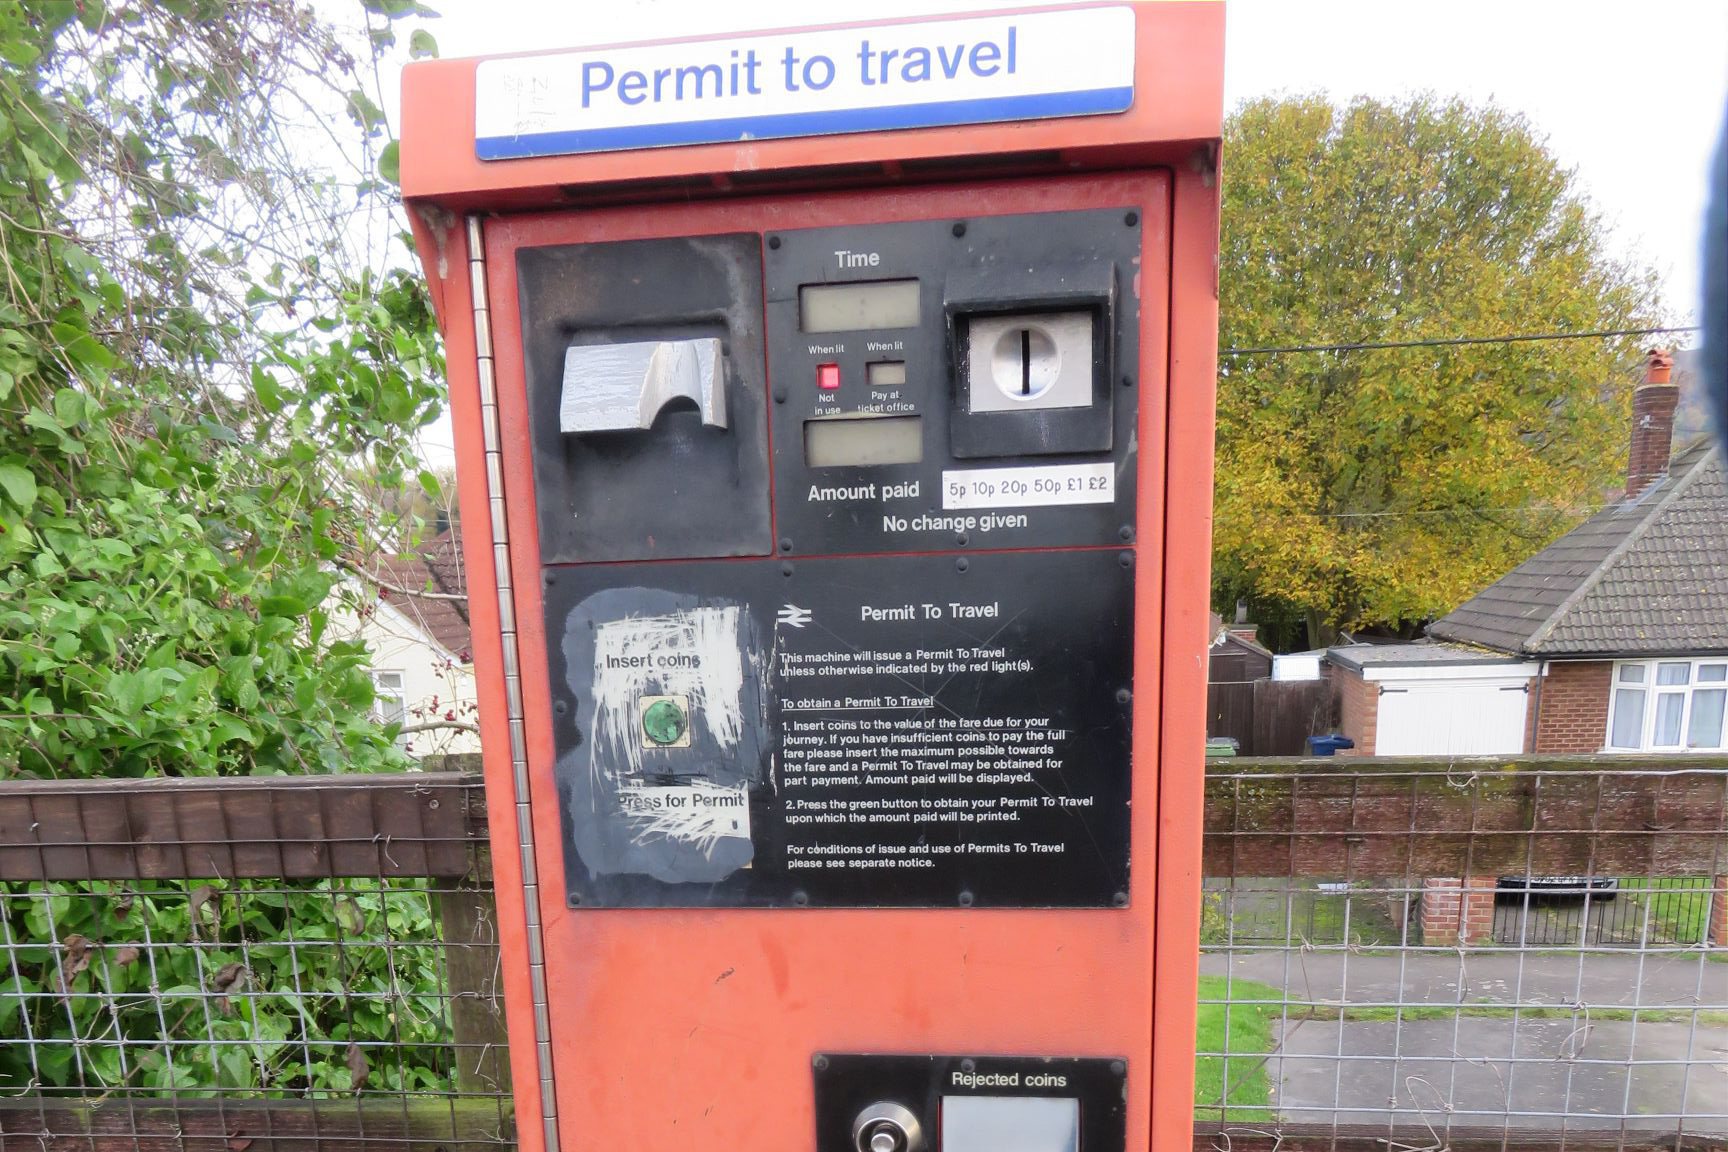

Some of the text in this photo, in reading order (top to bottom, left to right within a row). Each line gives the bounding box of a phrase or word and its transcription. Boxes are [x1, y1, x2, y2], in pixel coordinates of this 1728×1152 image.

[581, 49, 762, 108] Permit
[781, 46, 836, 91] to
[857, 26, 1017, 85] travel
[834, 250, 880, 269] Time
[808, 343, 845, 355] When lit
[867, 341, 903, 352] When lit
[818, 393, 835, 403] Not
[871, 391, 899, 401] Pay at
[814, 407, 841, 415] in use
[858, 402, 915, 413] ticket office
[808, 480, 920, 502] Amount paid
[949, 476, 1107, 499] 5p 10p 20p 50p £1 £2
[883, 512, 1028, 533] No change given
[861, 601, 999, 621] Permit To Travel
[606, 651, 701, 669] Insert coins
[780, 648, 1005, 664] This machine will issue a Permit To Travel
[780, 660, 1034, 677] unless otherwise indicated by the red light(s).
[781, 696, 934, 709] To obtain a Permit To Travel
[782, 717, 1049, 731] 1. Insert coins to the value of the fare due for your
[783, 730, 1065, 747] journey. If you have insufficient coins to pay the full
[783, 744, 1054, 760] fare please insert the maximum possible towards
[784, 763, 802, 772] the
[804, 762, 826, 772] fare
[829, 762, 849, 772] and
[862, 761, 898, 771] Permit
[900, 760, 914, 770] To
[915, 760, 949, 770] Travel
[951, 762, 974, 772] may
[977, 759, 991, 769] be
[993, 759, 1043, 769] obtained
[1046, 758, 1063, 768] for
[784, 772, 1034, 788] part payment. Amount paid will be displayed.
[665, 793, 687, 807] for
[692, 792, 745, 807] Permit
[786, 796, 1093, 811] 2. Press the green button to obtain your Permit To Travel
[786, 811, 1020, 825] upon which the amount paid will be printed.
[787, 843, 1064, 854] For conditions of issue and use of Permits To Travel
[788, 858, 935, 869] please see separate notice.
[952, 1071, 1067, 1089] Rejected coins
